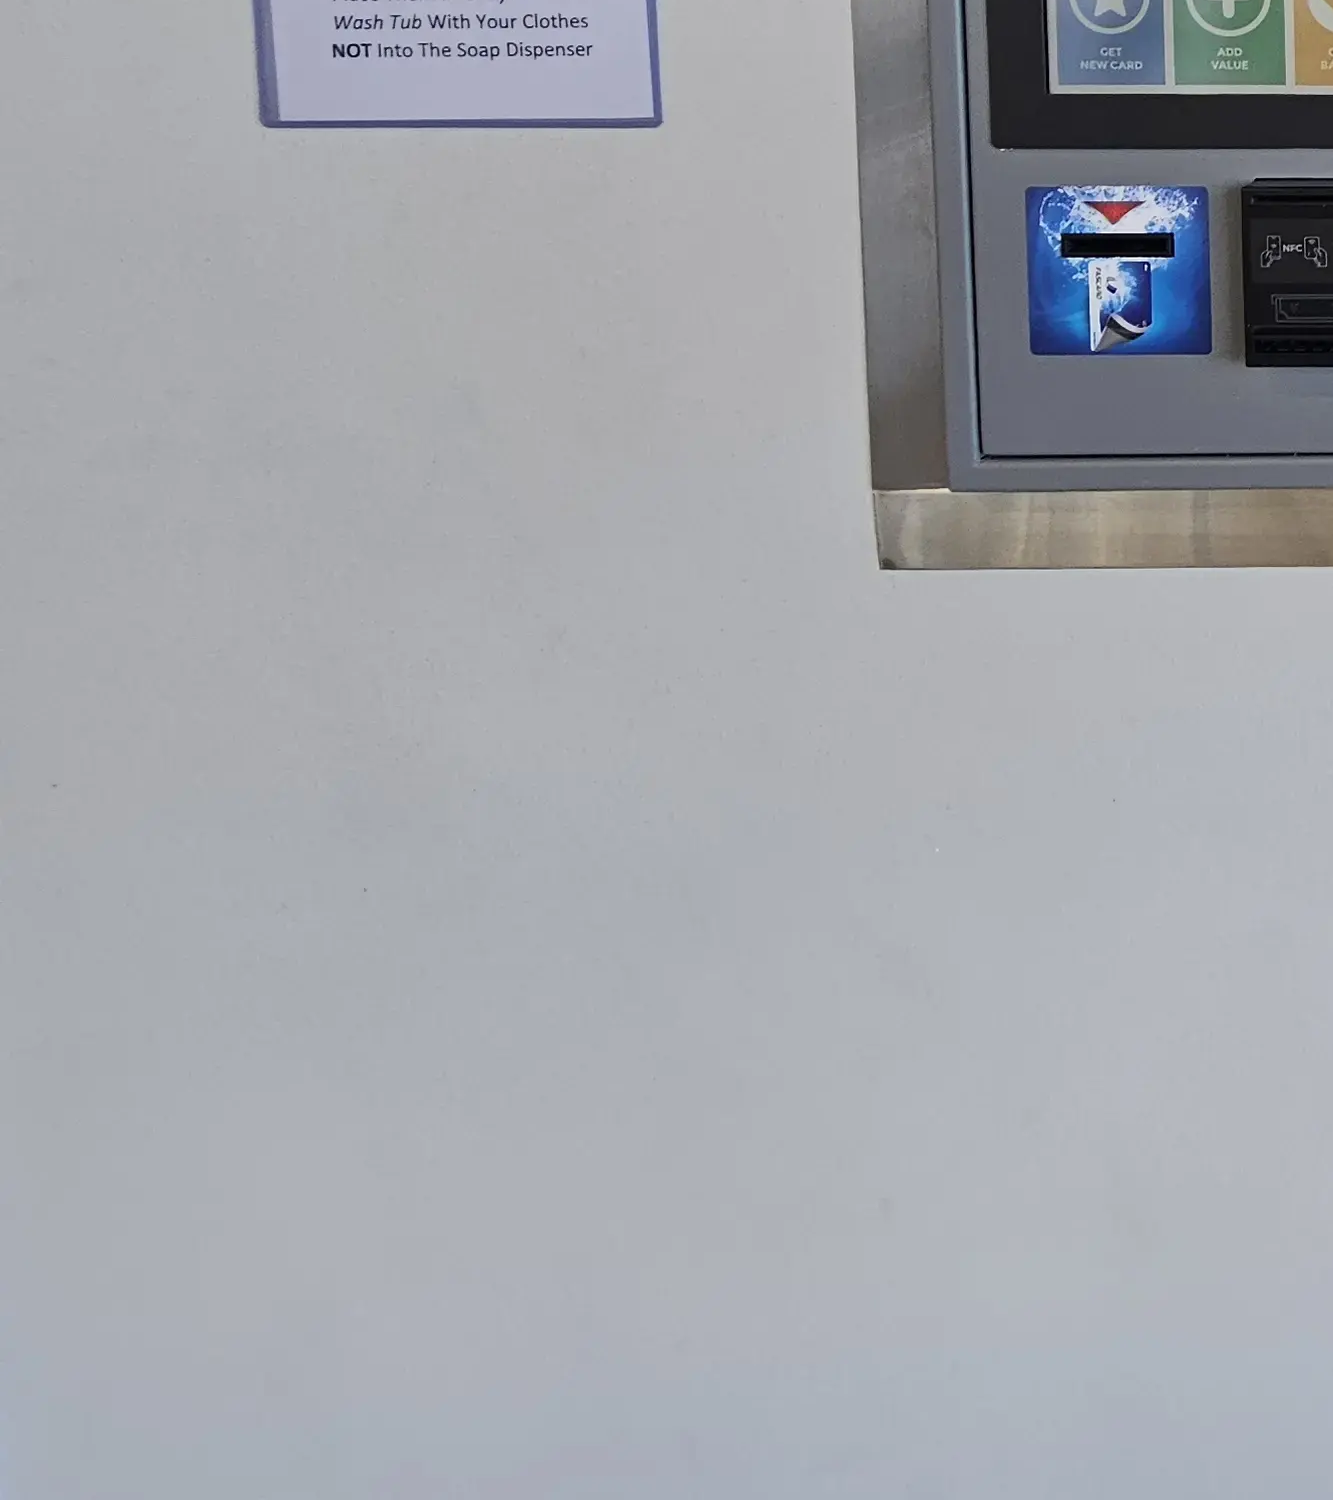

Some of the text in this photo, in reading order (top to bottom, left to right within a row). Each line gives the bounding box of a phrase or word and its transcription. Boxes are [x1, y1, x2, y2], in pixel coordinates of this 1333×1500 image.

[332, 41, 593, 61] NOT Into The Soap Dispenser
[1099, 46, 1122, 57] GET
[1216, 47, 1243, 57] ADD
[1079, 60, 1143, 70] NEW CARD
[1210, 60, 1248, 70] VALUE
[1282, 243, 1303, 252] NFC
